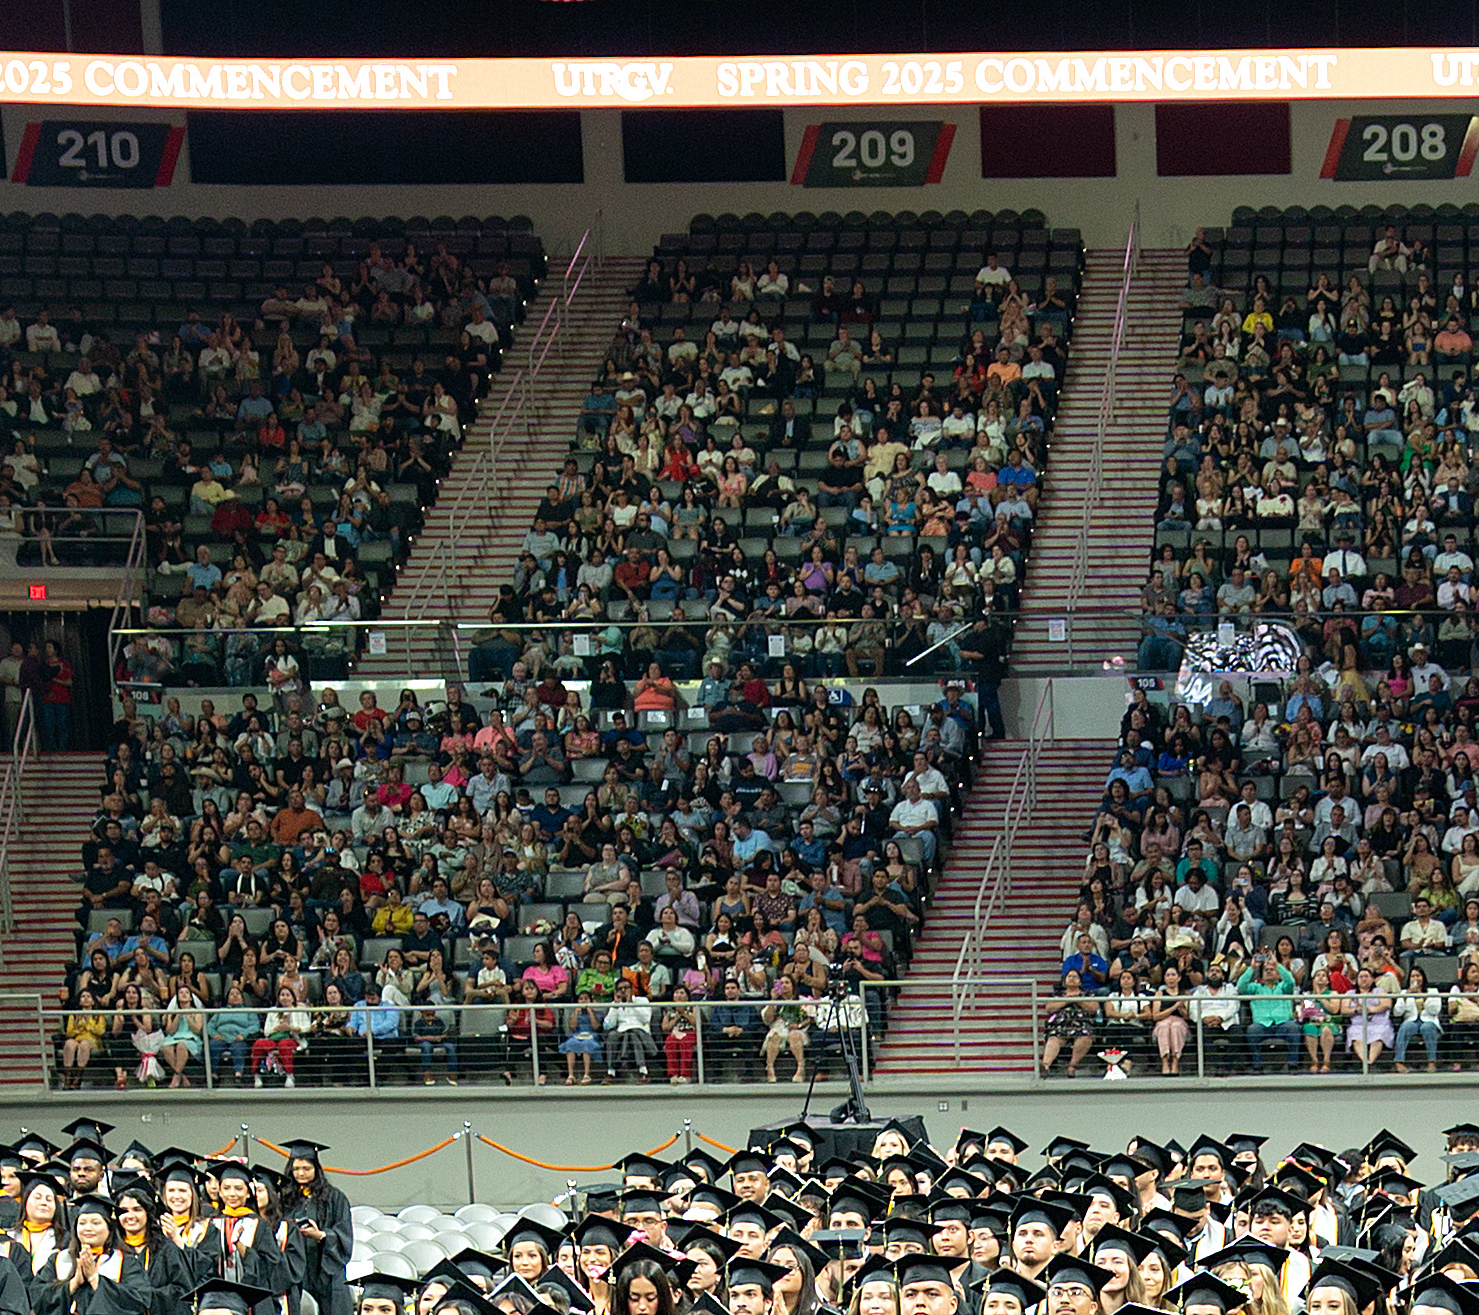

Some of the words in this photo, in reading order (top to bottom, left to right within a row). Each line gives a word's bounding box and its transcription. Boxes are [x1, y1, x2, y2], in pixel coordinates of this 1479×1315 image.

[84, 59, 458, 99] COMMENCEMENT
[715, 60, 870, 97] SPRING
[881, 60, 965, 95] 2025
[974, 54, 1338, 94] COMMENCEMENT
[56, 129, 140, 169] 210
[832, 129, 916, 168] 209
[1362, 123, 1447, 162] 208
